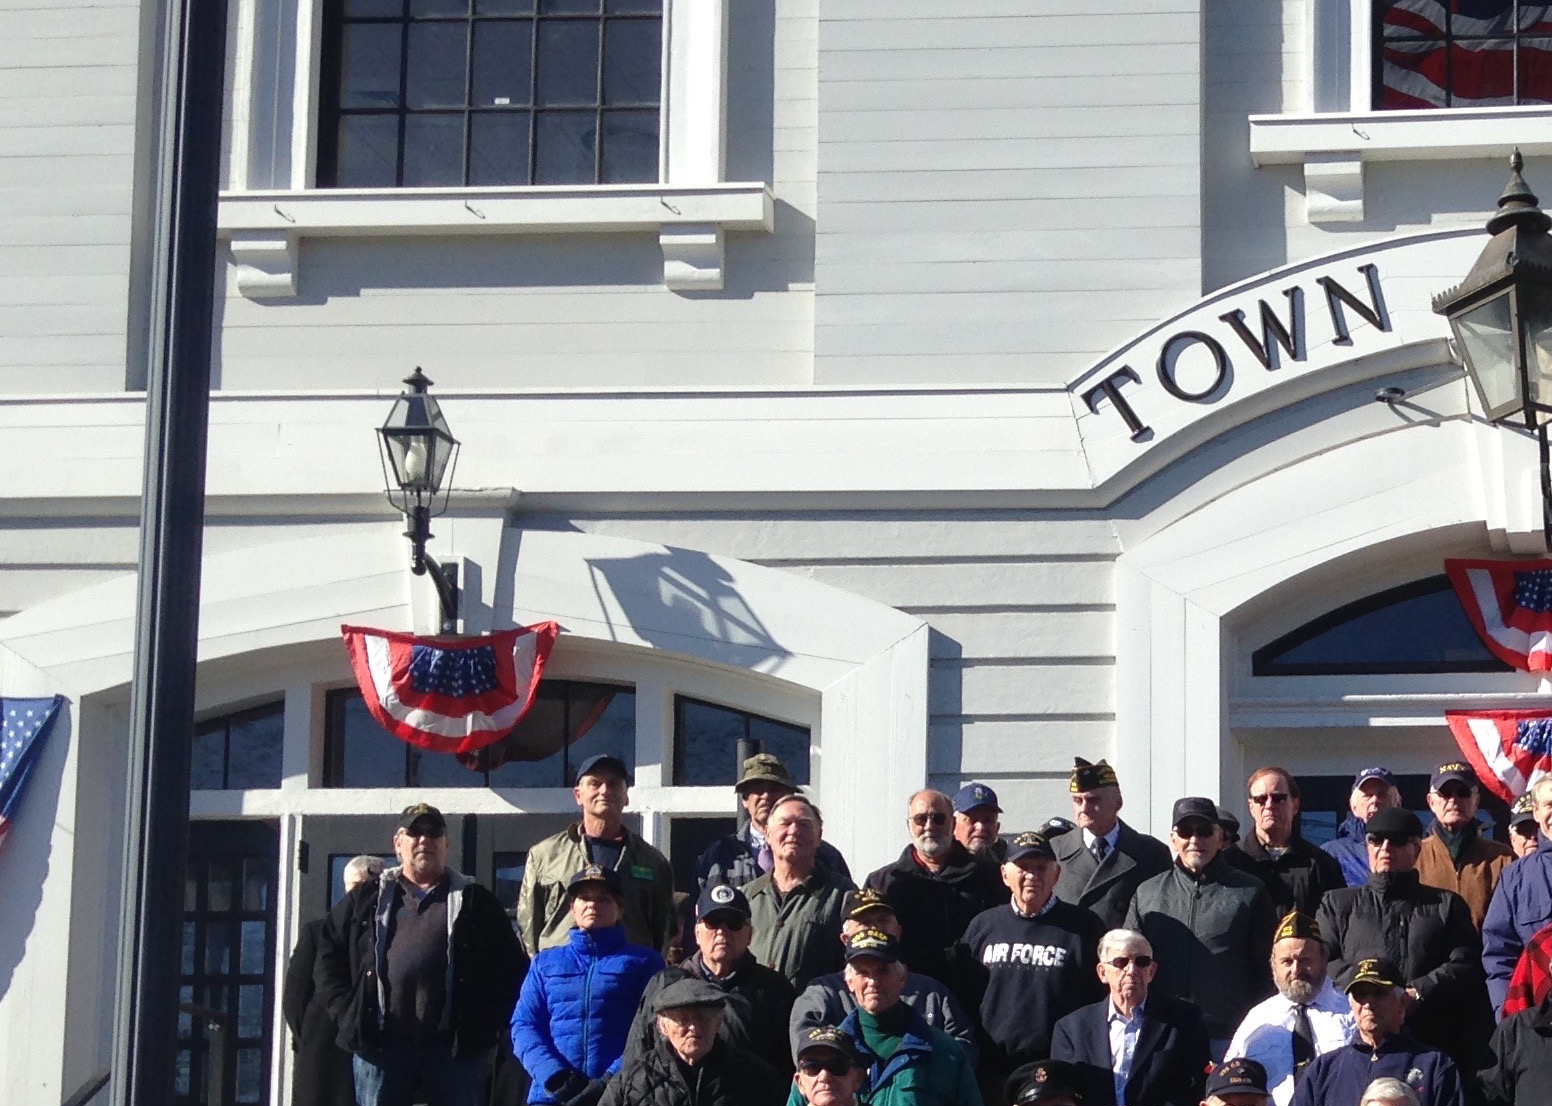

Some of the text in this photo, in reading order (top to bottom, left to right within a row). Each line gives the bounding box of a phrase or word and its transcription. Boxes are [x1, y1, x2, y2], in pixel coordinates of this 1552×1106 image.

[1080, 264, 1391, 442] TOWN
[983, 942, 1067, 967] AIR FORCE
